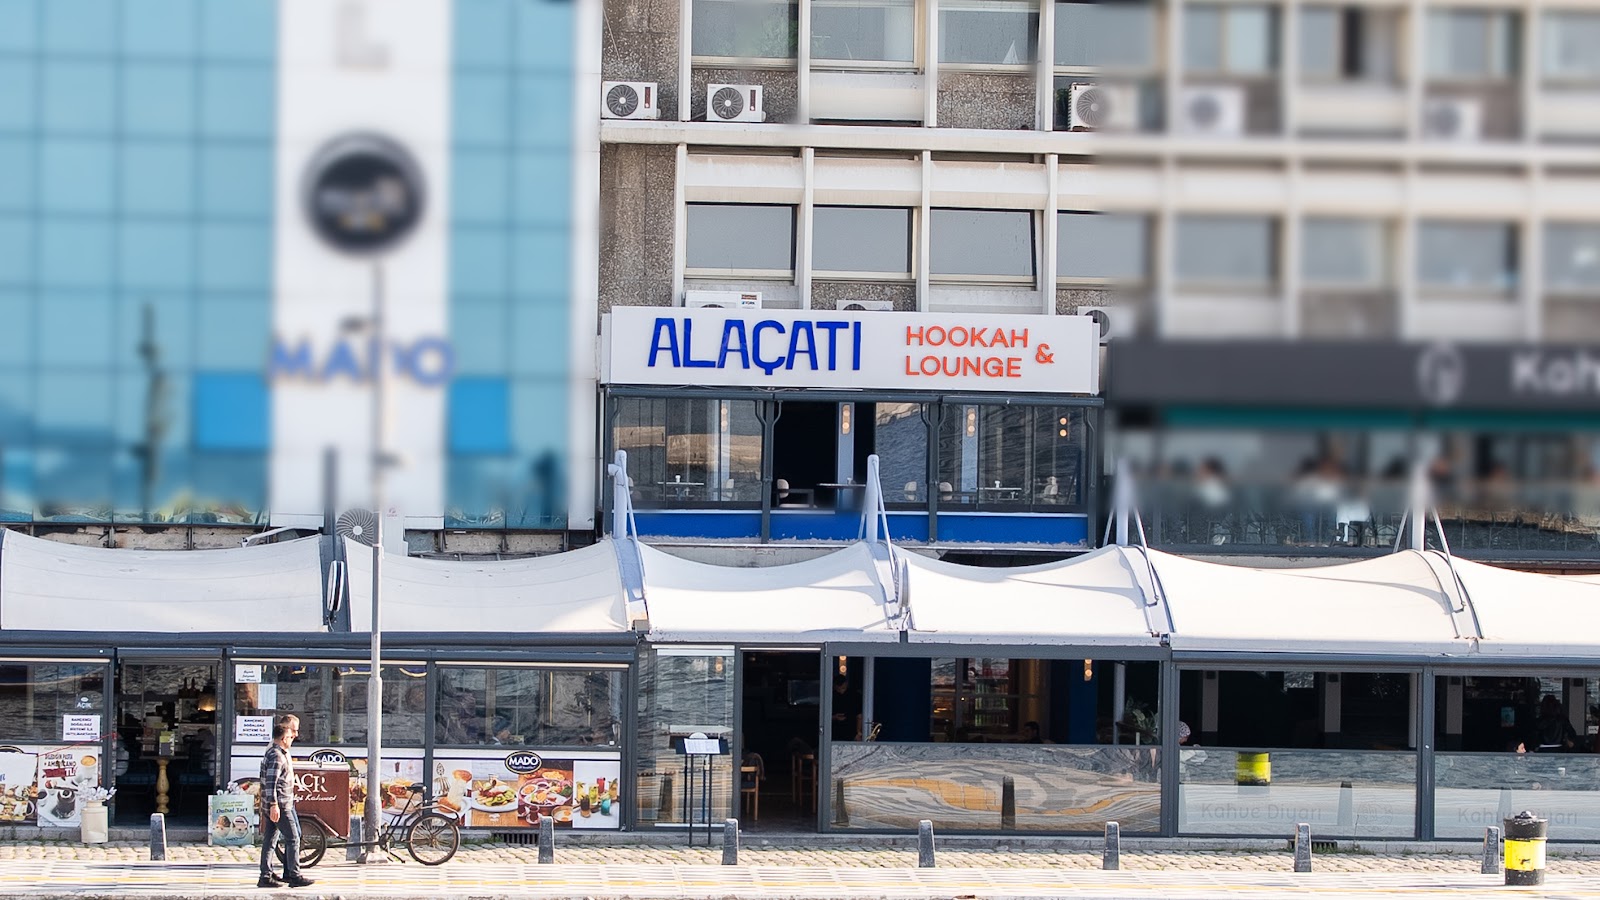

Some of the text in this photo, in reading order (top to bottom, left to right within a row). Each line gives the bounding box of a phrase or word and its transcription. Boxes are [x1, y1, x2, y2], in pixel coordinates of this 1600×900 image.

[647, 317, 861, 375] ALAÇATI
[906, 325, 1029, 350] HOOKAH
[1035, 343, 1054, 365] &
[905, 355, 1022, 378] LOUNGE
[508, 756, 539, 766] MADO
